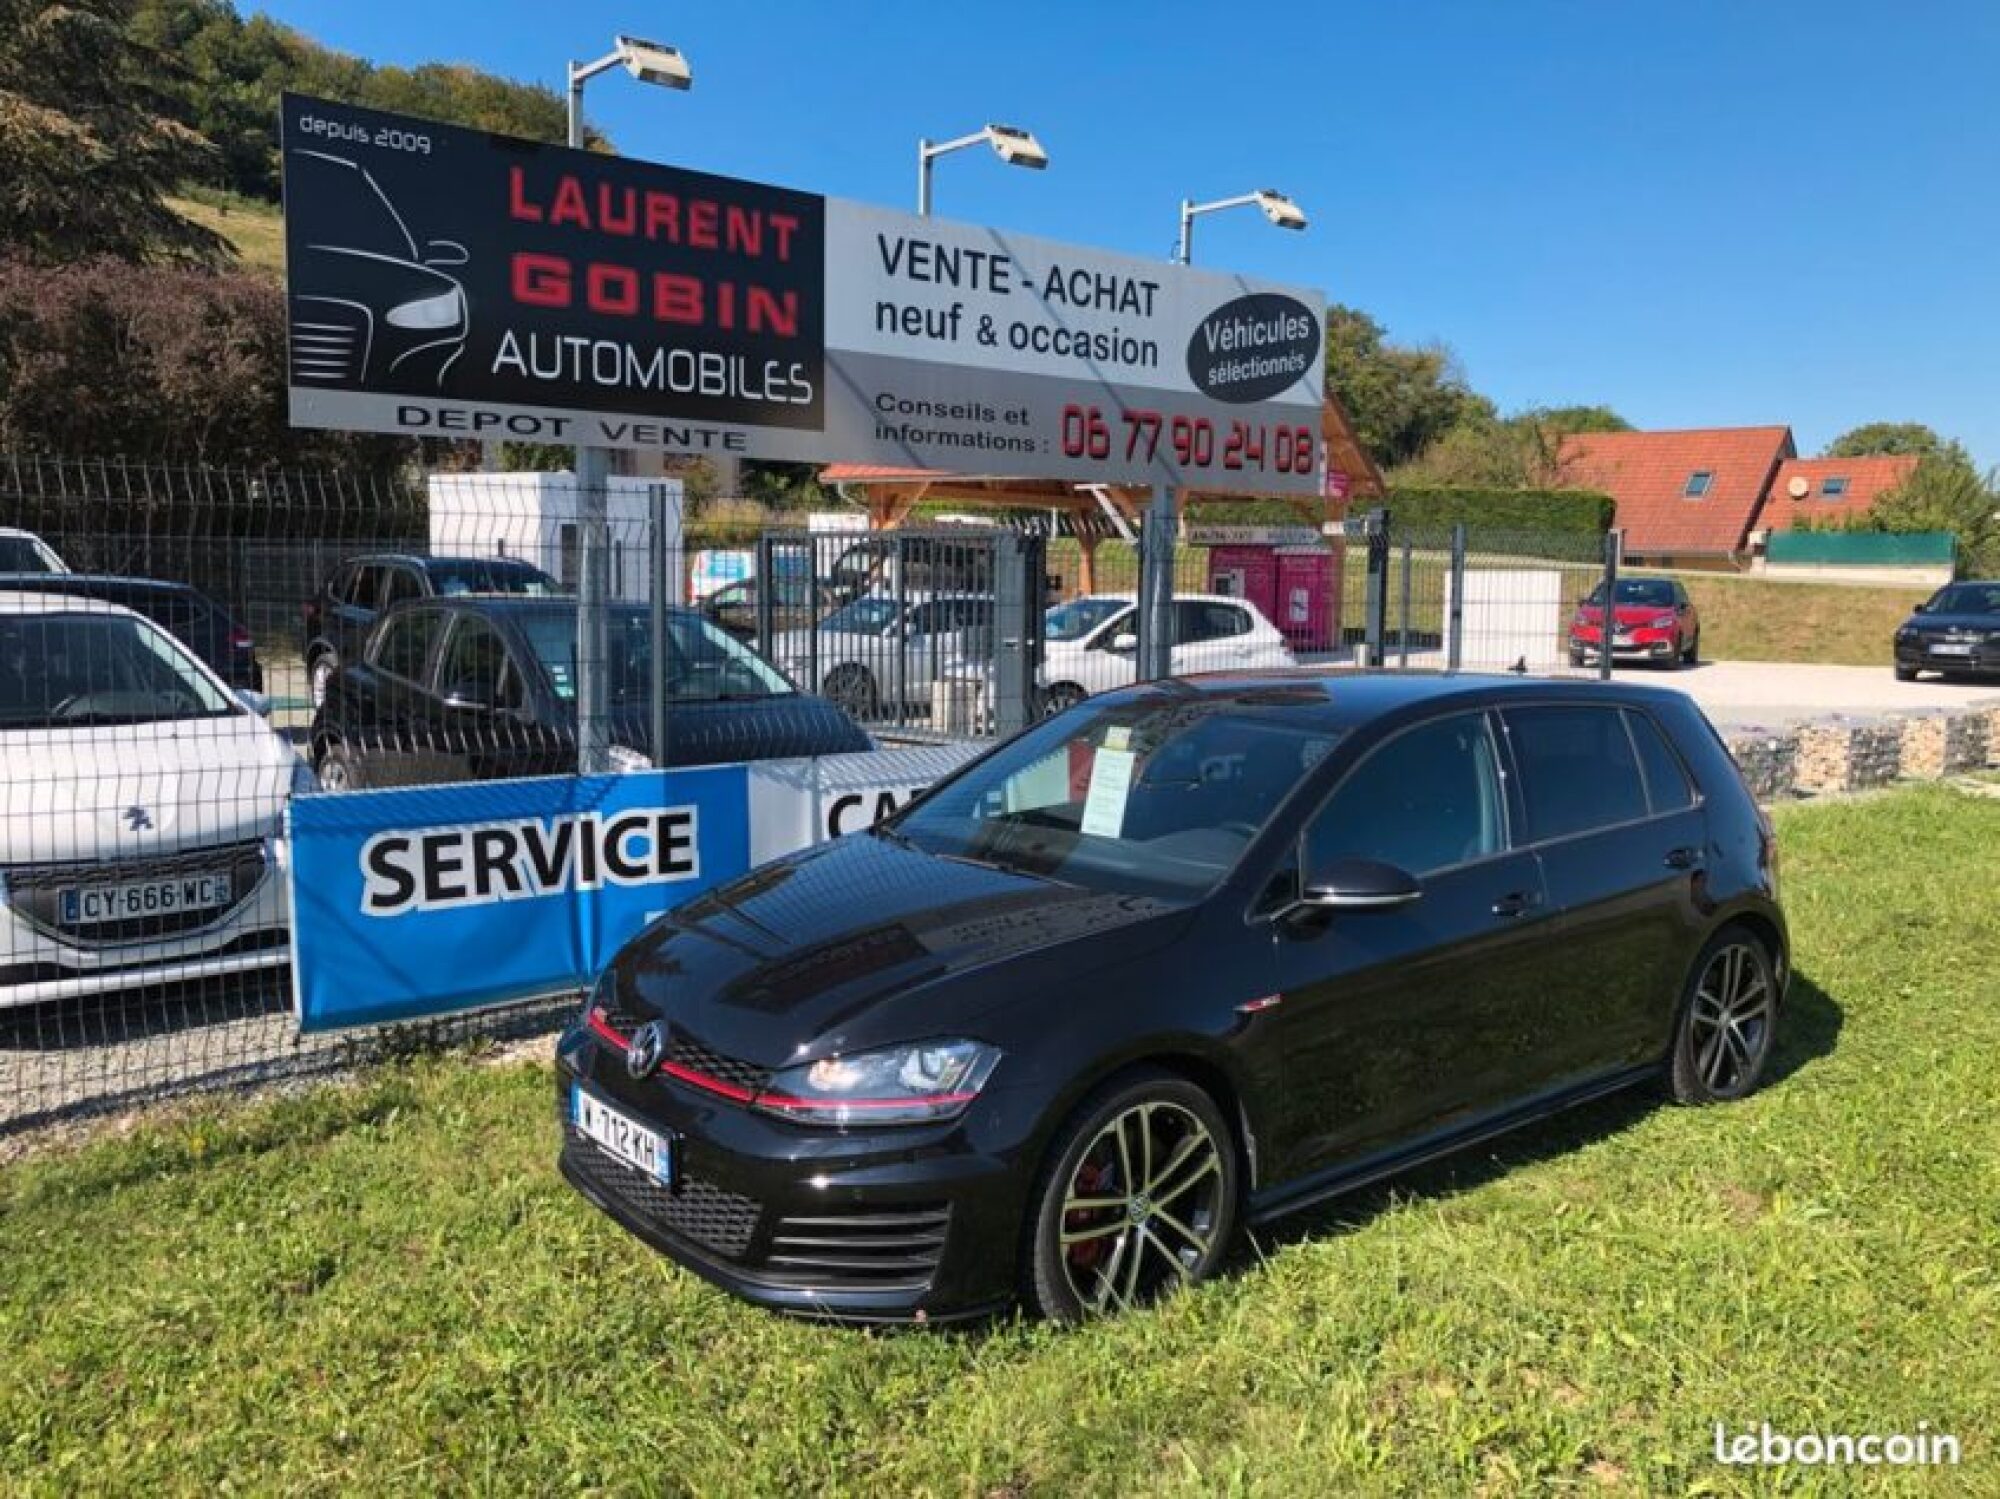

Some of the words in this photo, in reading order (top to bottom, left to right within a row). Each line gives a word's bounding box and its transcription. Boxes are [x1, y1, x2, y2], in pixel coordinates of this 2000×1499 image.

[299, 114, 369, 144] depuis
[374, 128, 431, 154] 2009
[509, 166, 800, 262] LAURENT
[510, 252, 799, 338] GOBIN
[878, 232, 1011, 295] VENTE
[1043, 264, 1160, 317] ACHAT
[876, 301, 963, 341] neuf
[977, 314, 998, 347] &
[1009, 321, 1158, 368] occasion
[1204, 312, 1309, 352] Véhicules
[491, 328, 813, 404] AUTOMOBILES
[398, 406, 571, 437] DEPOT
[600, 419, 746, 451] VENTE
[875, 393, 995, 424] Conseils
[1004, 408, 1030, 426] et
[875, 422, 1035, 453] informations
[1062, 404, 1110, 459] 06
[1122, 407, 1162, 464] 77
[1172, 415, 1213, 467] 90
[1224, 417, 1266, 472] 24
[1275, 424, 1312, 474] 08
[828, 788, 929, 838] CA
[370, 813, 694, 908] SERVICE
